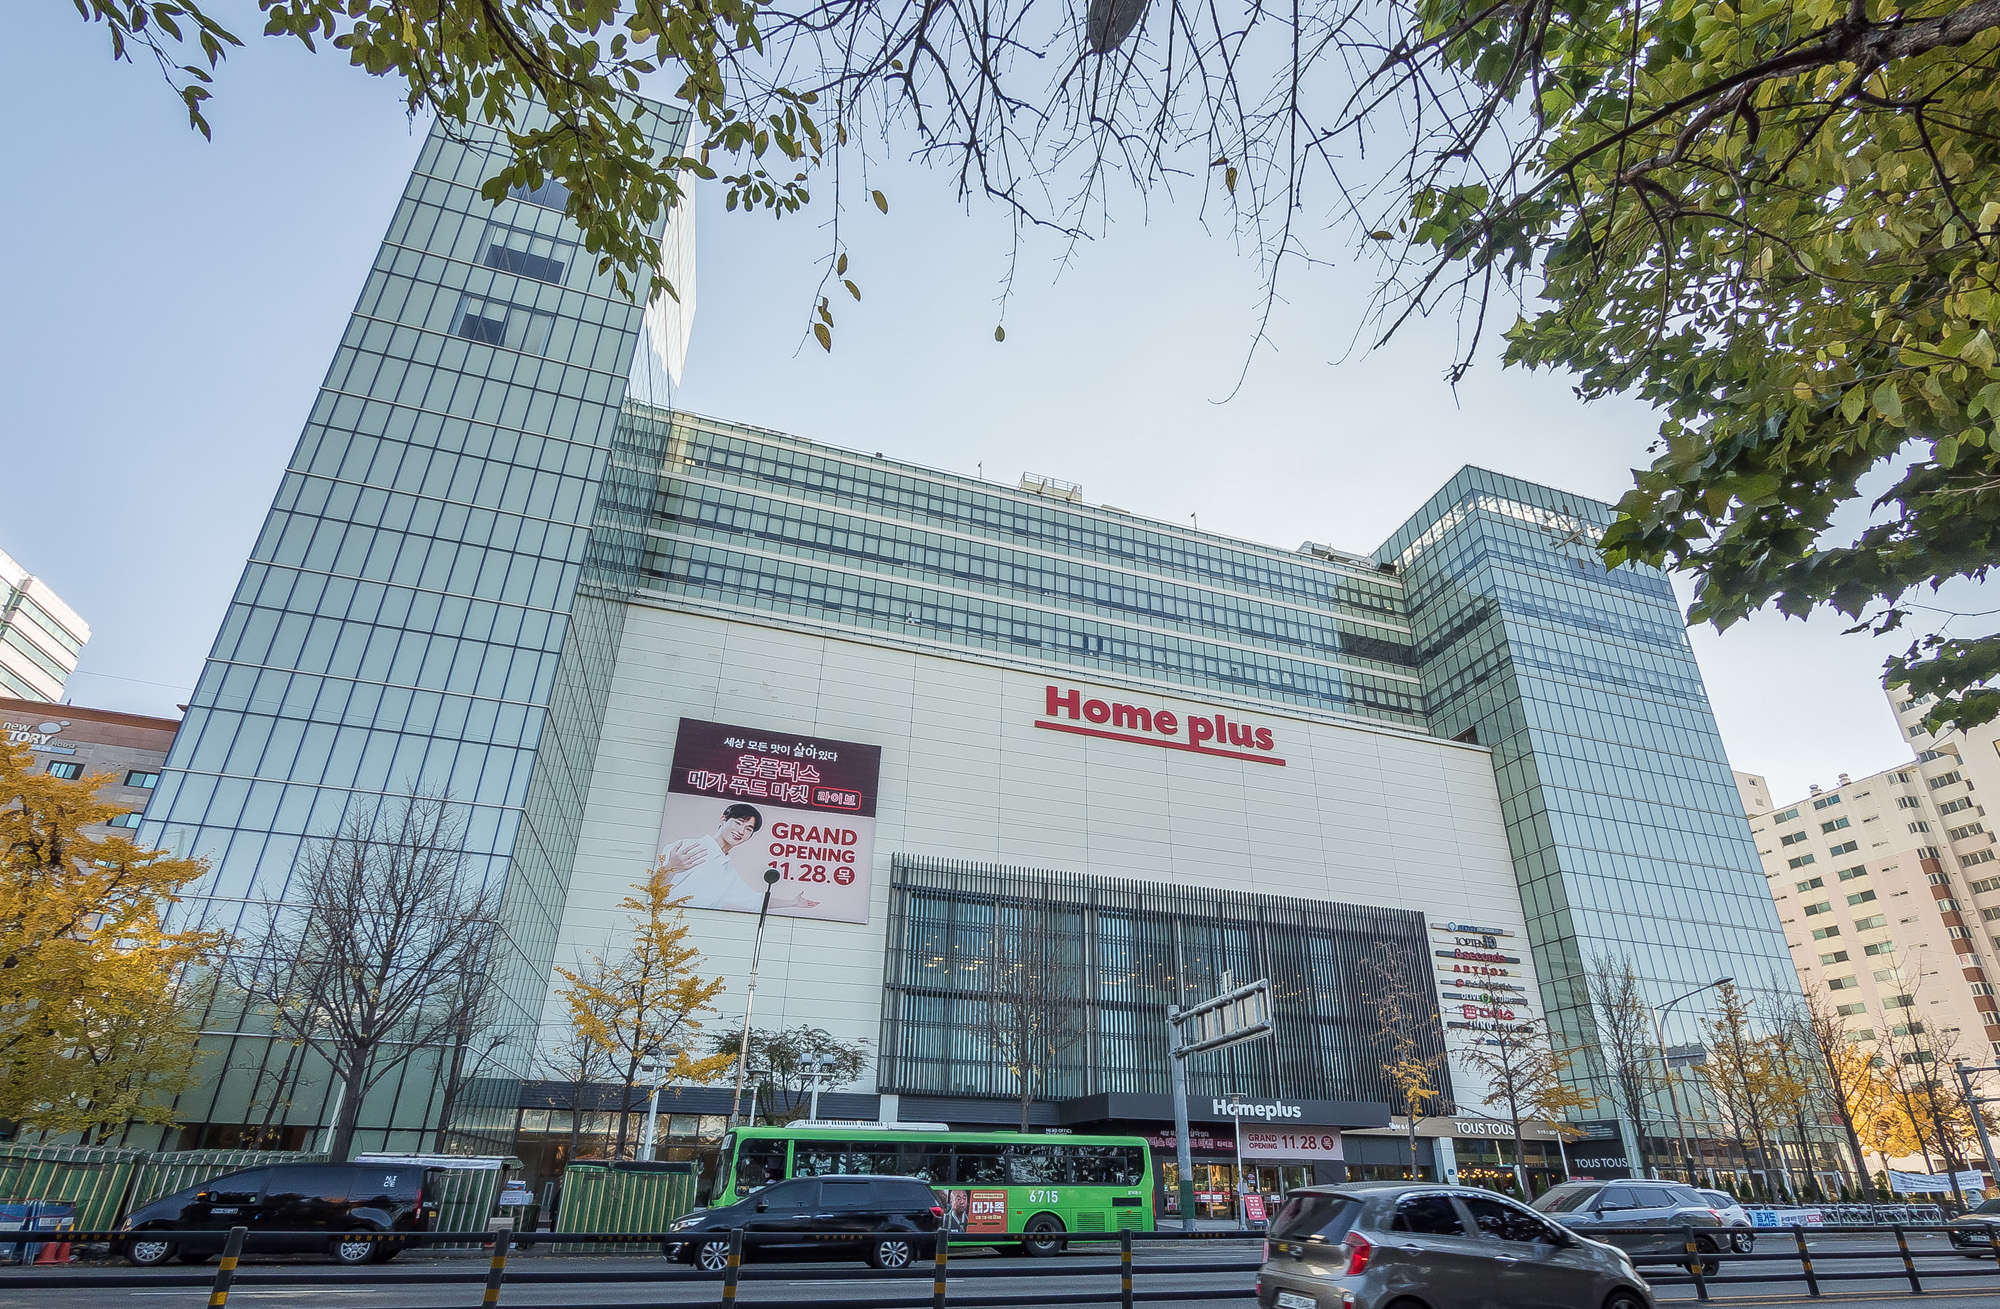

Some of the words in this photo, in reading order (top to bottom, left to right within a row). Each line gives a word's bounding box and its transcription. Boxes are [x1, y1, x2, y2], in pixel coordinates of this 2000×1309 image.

[1046, 685, 1178, 735] Home
[1188, 714, 1275, 751] plus
[2, 721, 31, 731] new
[723, 737, 746, 749] 세상
[747, 740, 768, 753] 모든
[770, 743, 791, 756] 맛이
[792, 742, 838, 762] 살아있다
[737, 754, 821, 784] 홈플러스
[687, 770, 727, 793] 메가
[729, 775, 769, 797] 푸드
[770, 783, 810, 805] 마켓
[817, 791, 856, 807] 라이브
[771, 822, 858, 846] GRAND
[769, 842, 856, 864] OPENING
[1461, 993, 1481, 1001] OLIVE
[1212, 1098, 1302, 1121] Homeplus
[1455, 1122, 1485, 1135] TOUS
[1485, 1123, 1515, 1136] TOUS
[1248, 1133, 1277, 1143] GRAND
[1248, 1142, 1278, 1150] OPENING
[1574, 1158, 1601, 1168] TOUS
[1601, 1157, 1628, 1168] TOUS
[1029, 1189, 1059, 1204] 6715
[972, 1201, 1005, 1214] 대가족
